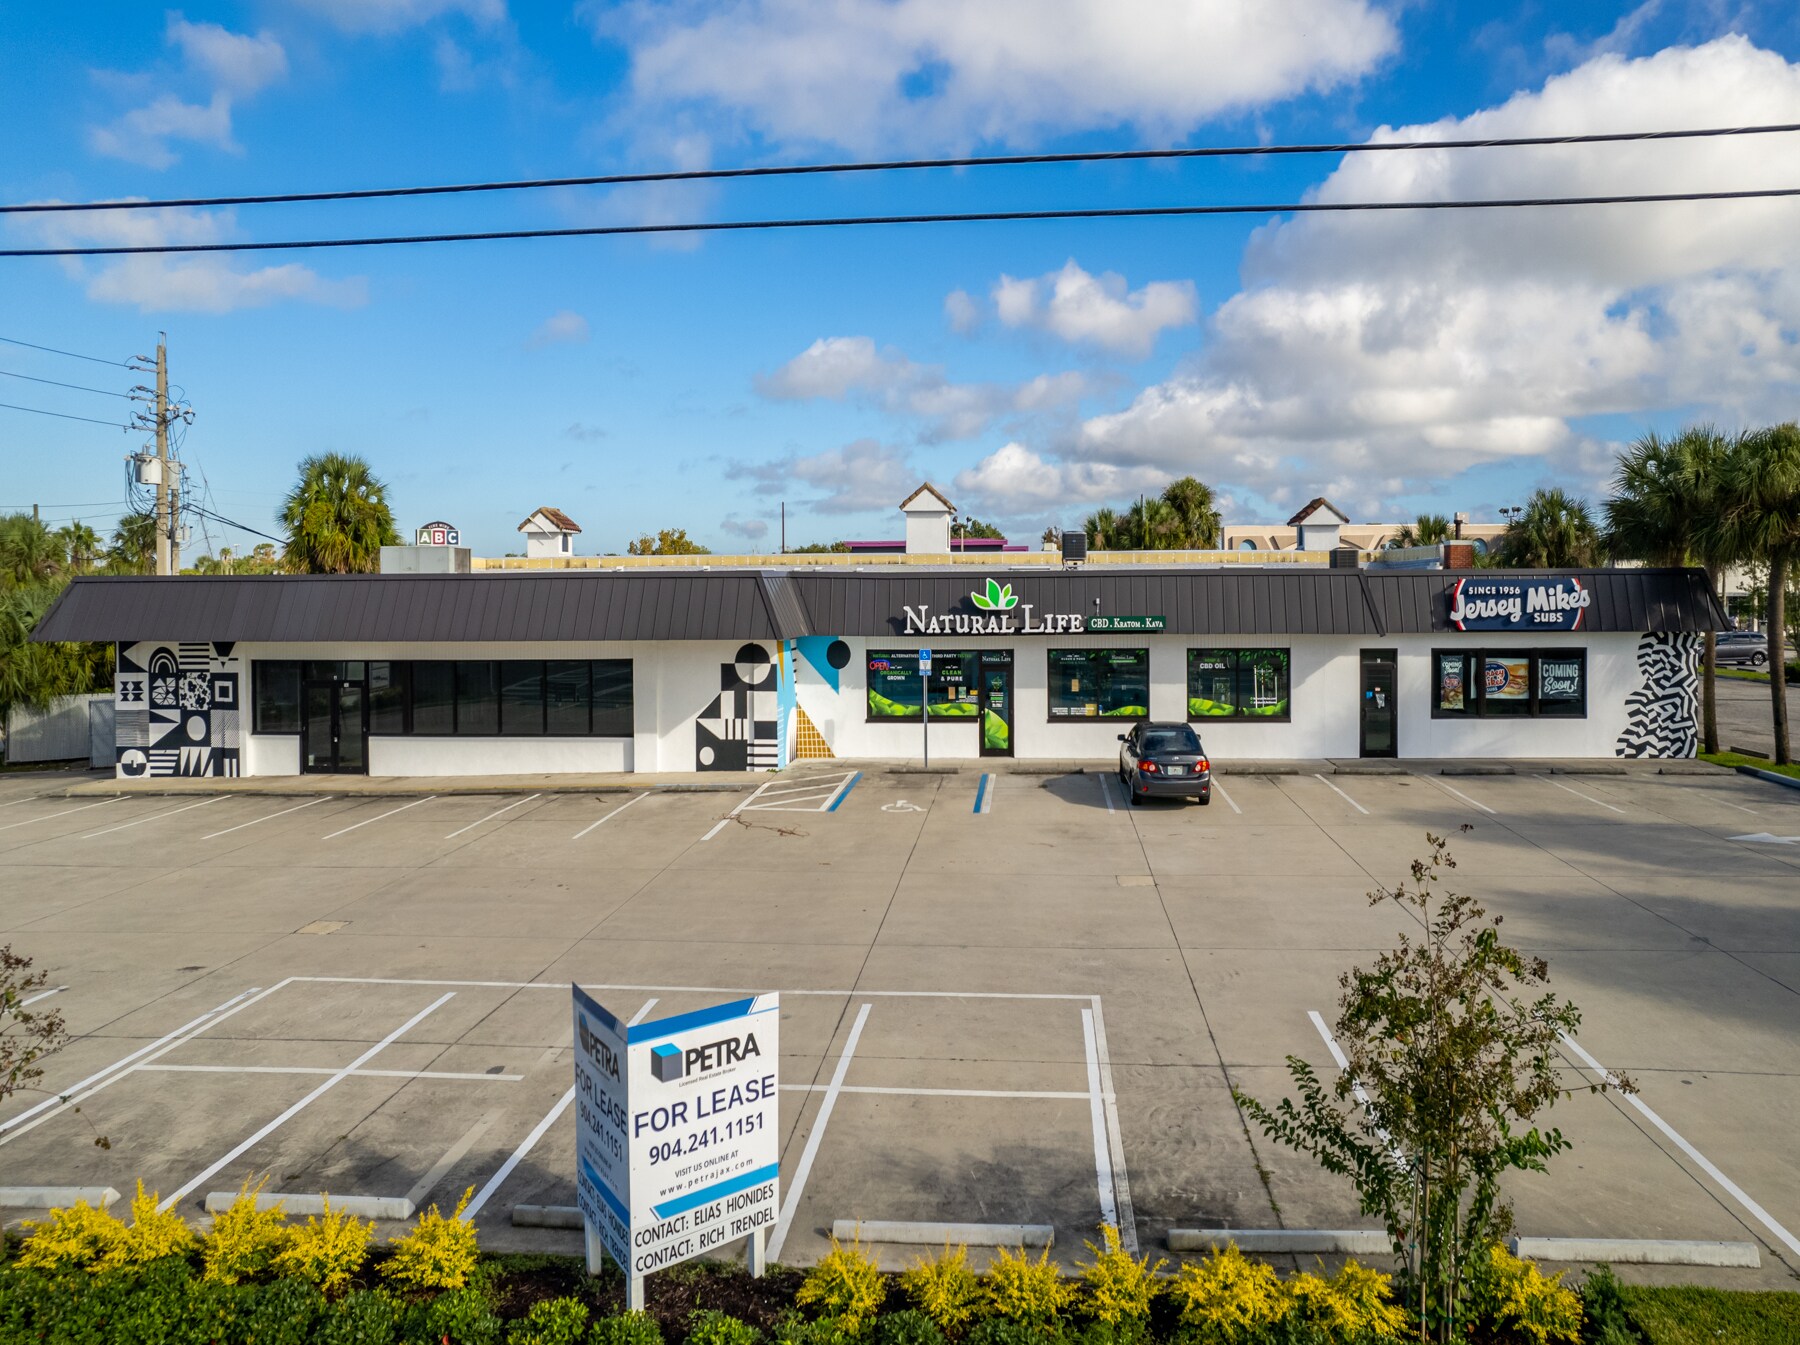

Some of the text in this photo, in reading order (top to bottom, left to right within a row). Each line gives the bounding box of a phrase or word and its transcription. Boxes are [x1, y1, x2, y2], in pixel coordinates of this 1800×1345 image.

[420, 532, 457, 544] ABC
[1450, 584, 1591, 623] Jersey Mike's
[1468, 586, 1520, 595] SINCE 1956
[1091, 619, 1108, 629] CBD
[1534, 612, 1563, 623] SUBS
[870, 661, 889, 671] OPEN
[1542, 664, 1579, 677] COMING
[1544, 677, 1579, 694] Soon!
[589, 1031, 620, 1084] PETRA
[685, 1032, 761, 1077] PETRA
[679, 1067, 736, 1088] Licensed Real Estate Broker
[575, 1062, 593, 1101] FOR
[594, 1082, 627, 1137] LEASE
[635, 1074, 775, 1139] FOR LEASE
[649, 1112, 763, 1166] 904.241.1151
[659, 1158, 753, 1197] www.petrajax.com
[675, 1149, 739, 1178] VISIT US ONLINE AT
[634, 1183, 774, 1248] CONTACT: ELIAS HIONIDES
[635, 1207, 775, 1272] CONTACT: RICH TRENDEL
